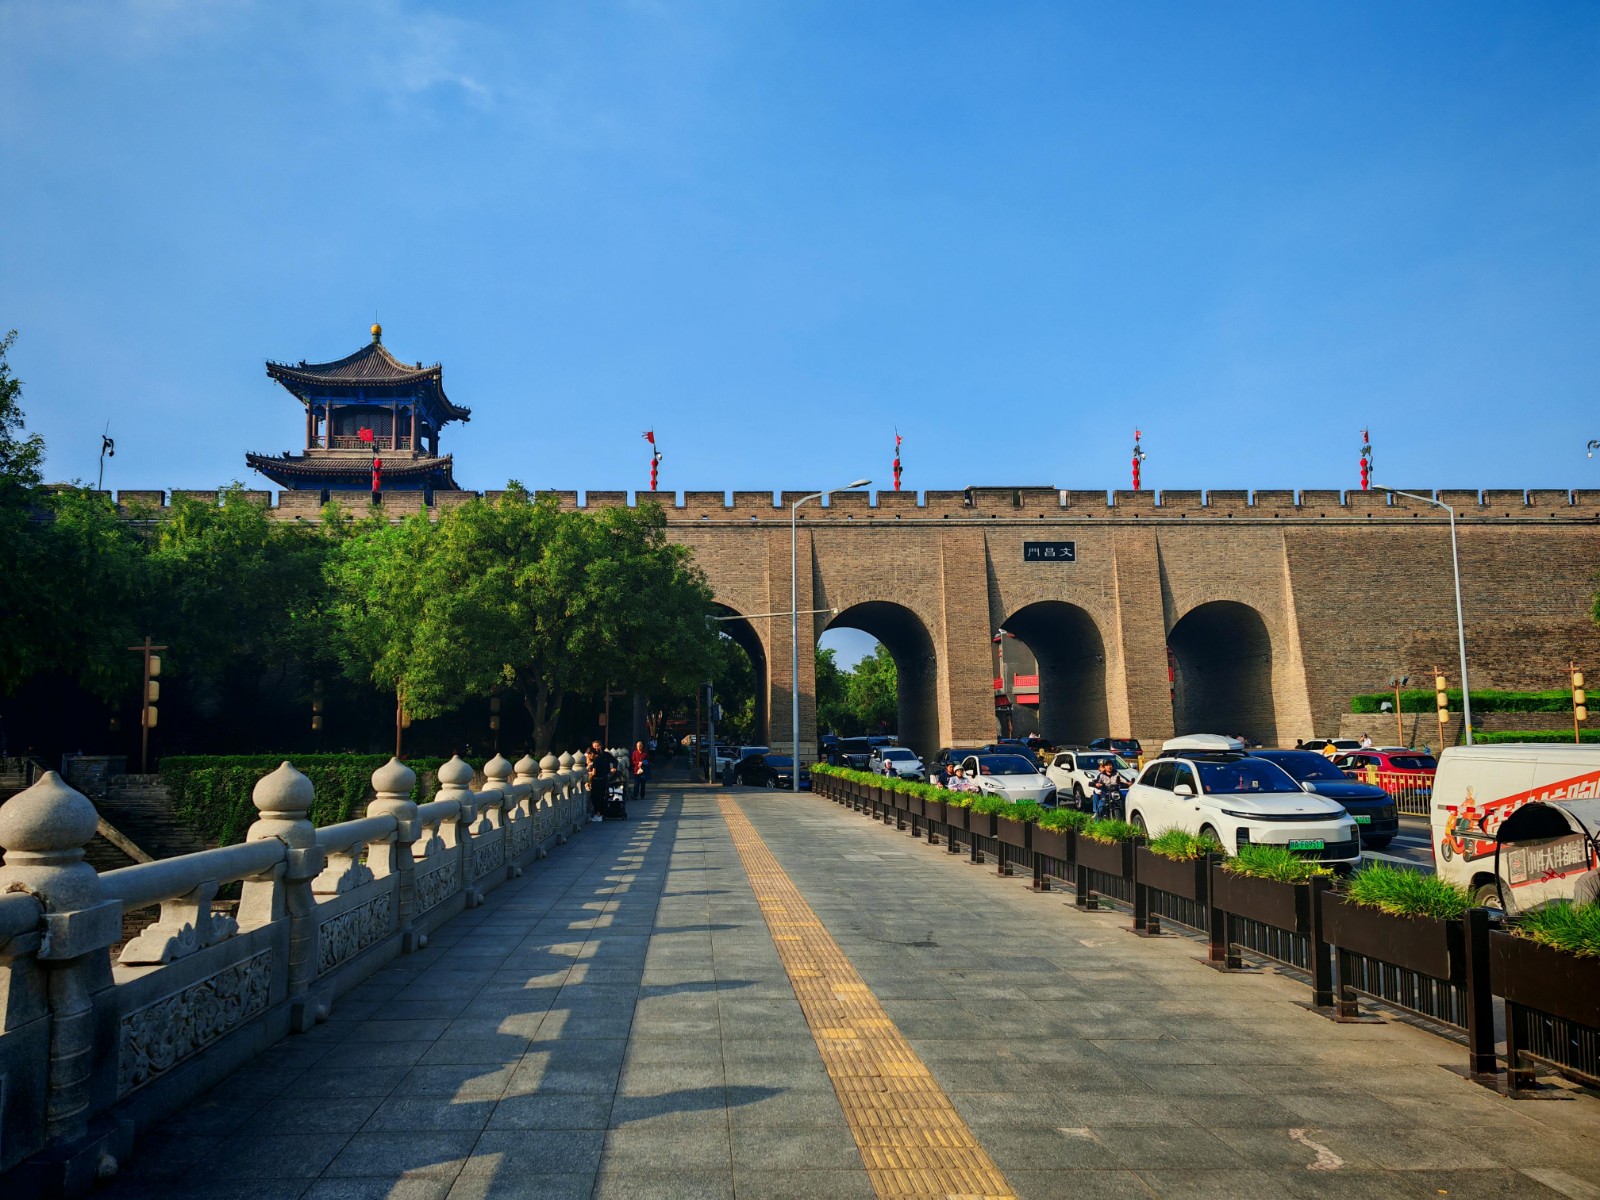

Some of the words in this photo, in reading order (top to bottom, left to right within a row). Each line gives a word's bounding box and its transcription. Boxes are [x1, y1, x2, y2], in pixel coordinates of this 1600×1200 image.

[1028, 547, 1073, 557] 文昌門
[1528, 839, 1592, 874] 小件大件都能
